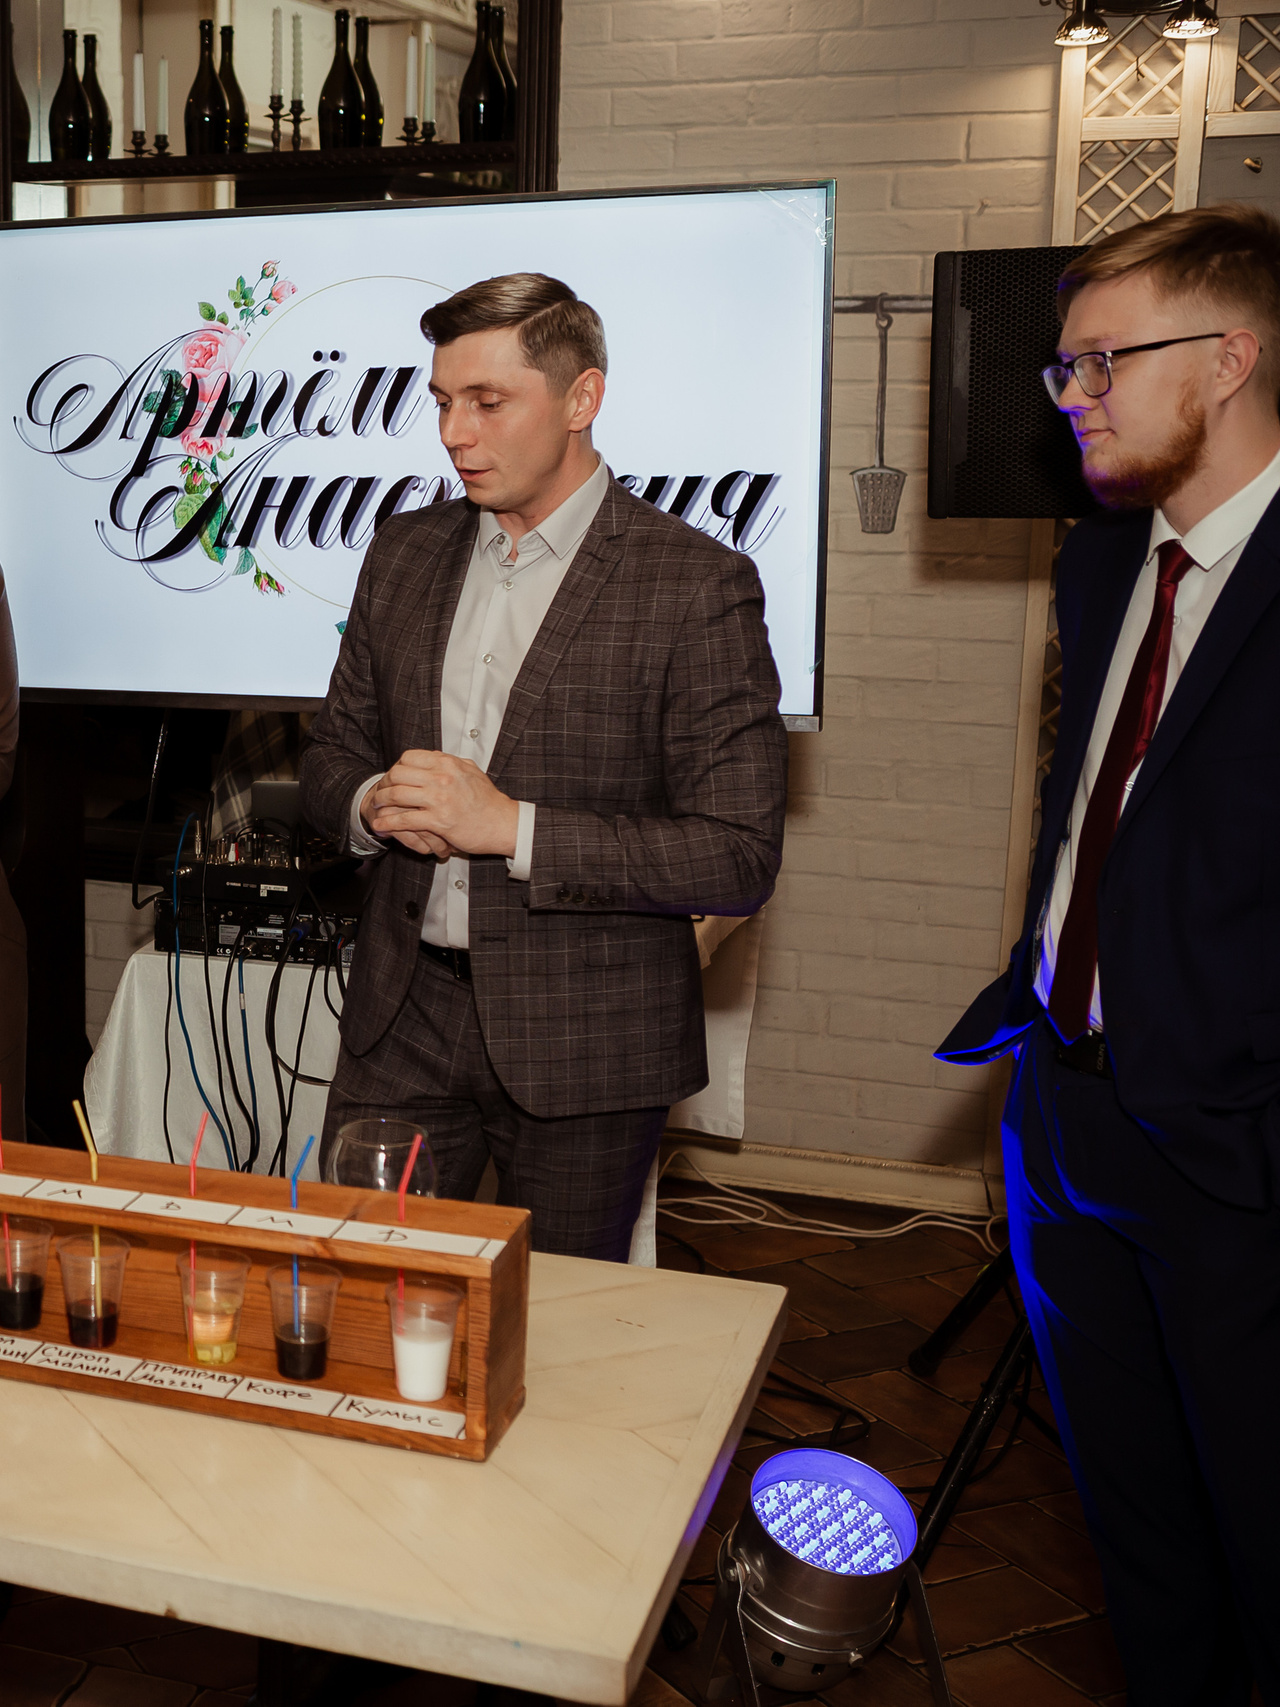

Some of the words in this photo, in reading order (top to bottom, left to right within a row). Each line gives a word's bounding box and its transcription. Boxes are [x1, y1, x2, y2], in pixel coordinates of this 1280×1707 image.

[13, 328, 422, 480] Артём
[95, 429, 780, 591] Анасия
[345, 1399, 443, 1428] Кумыс
